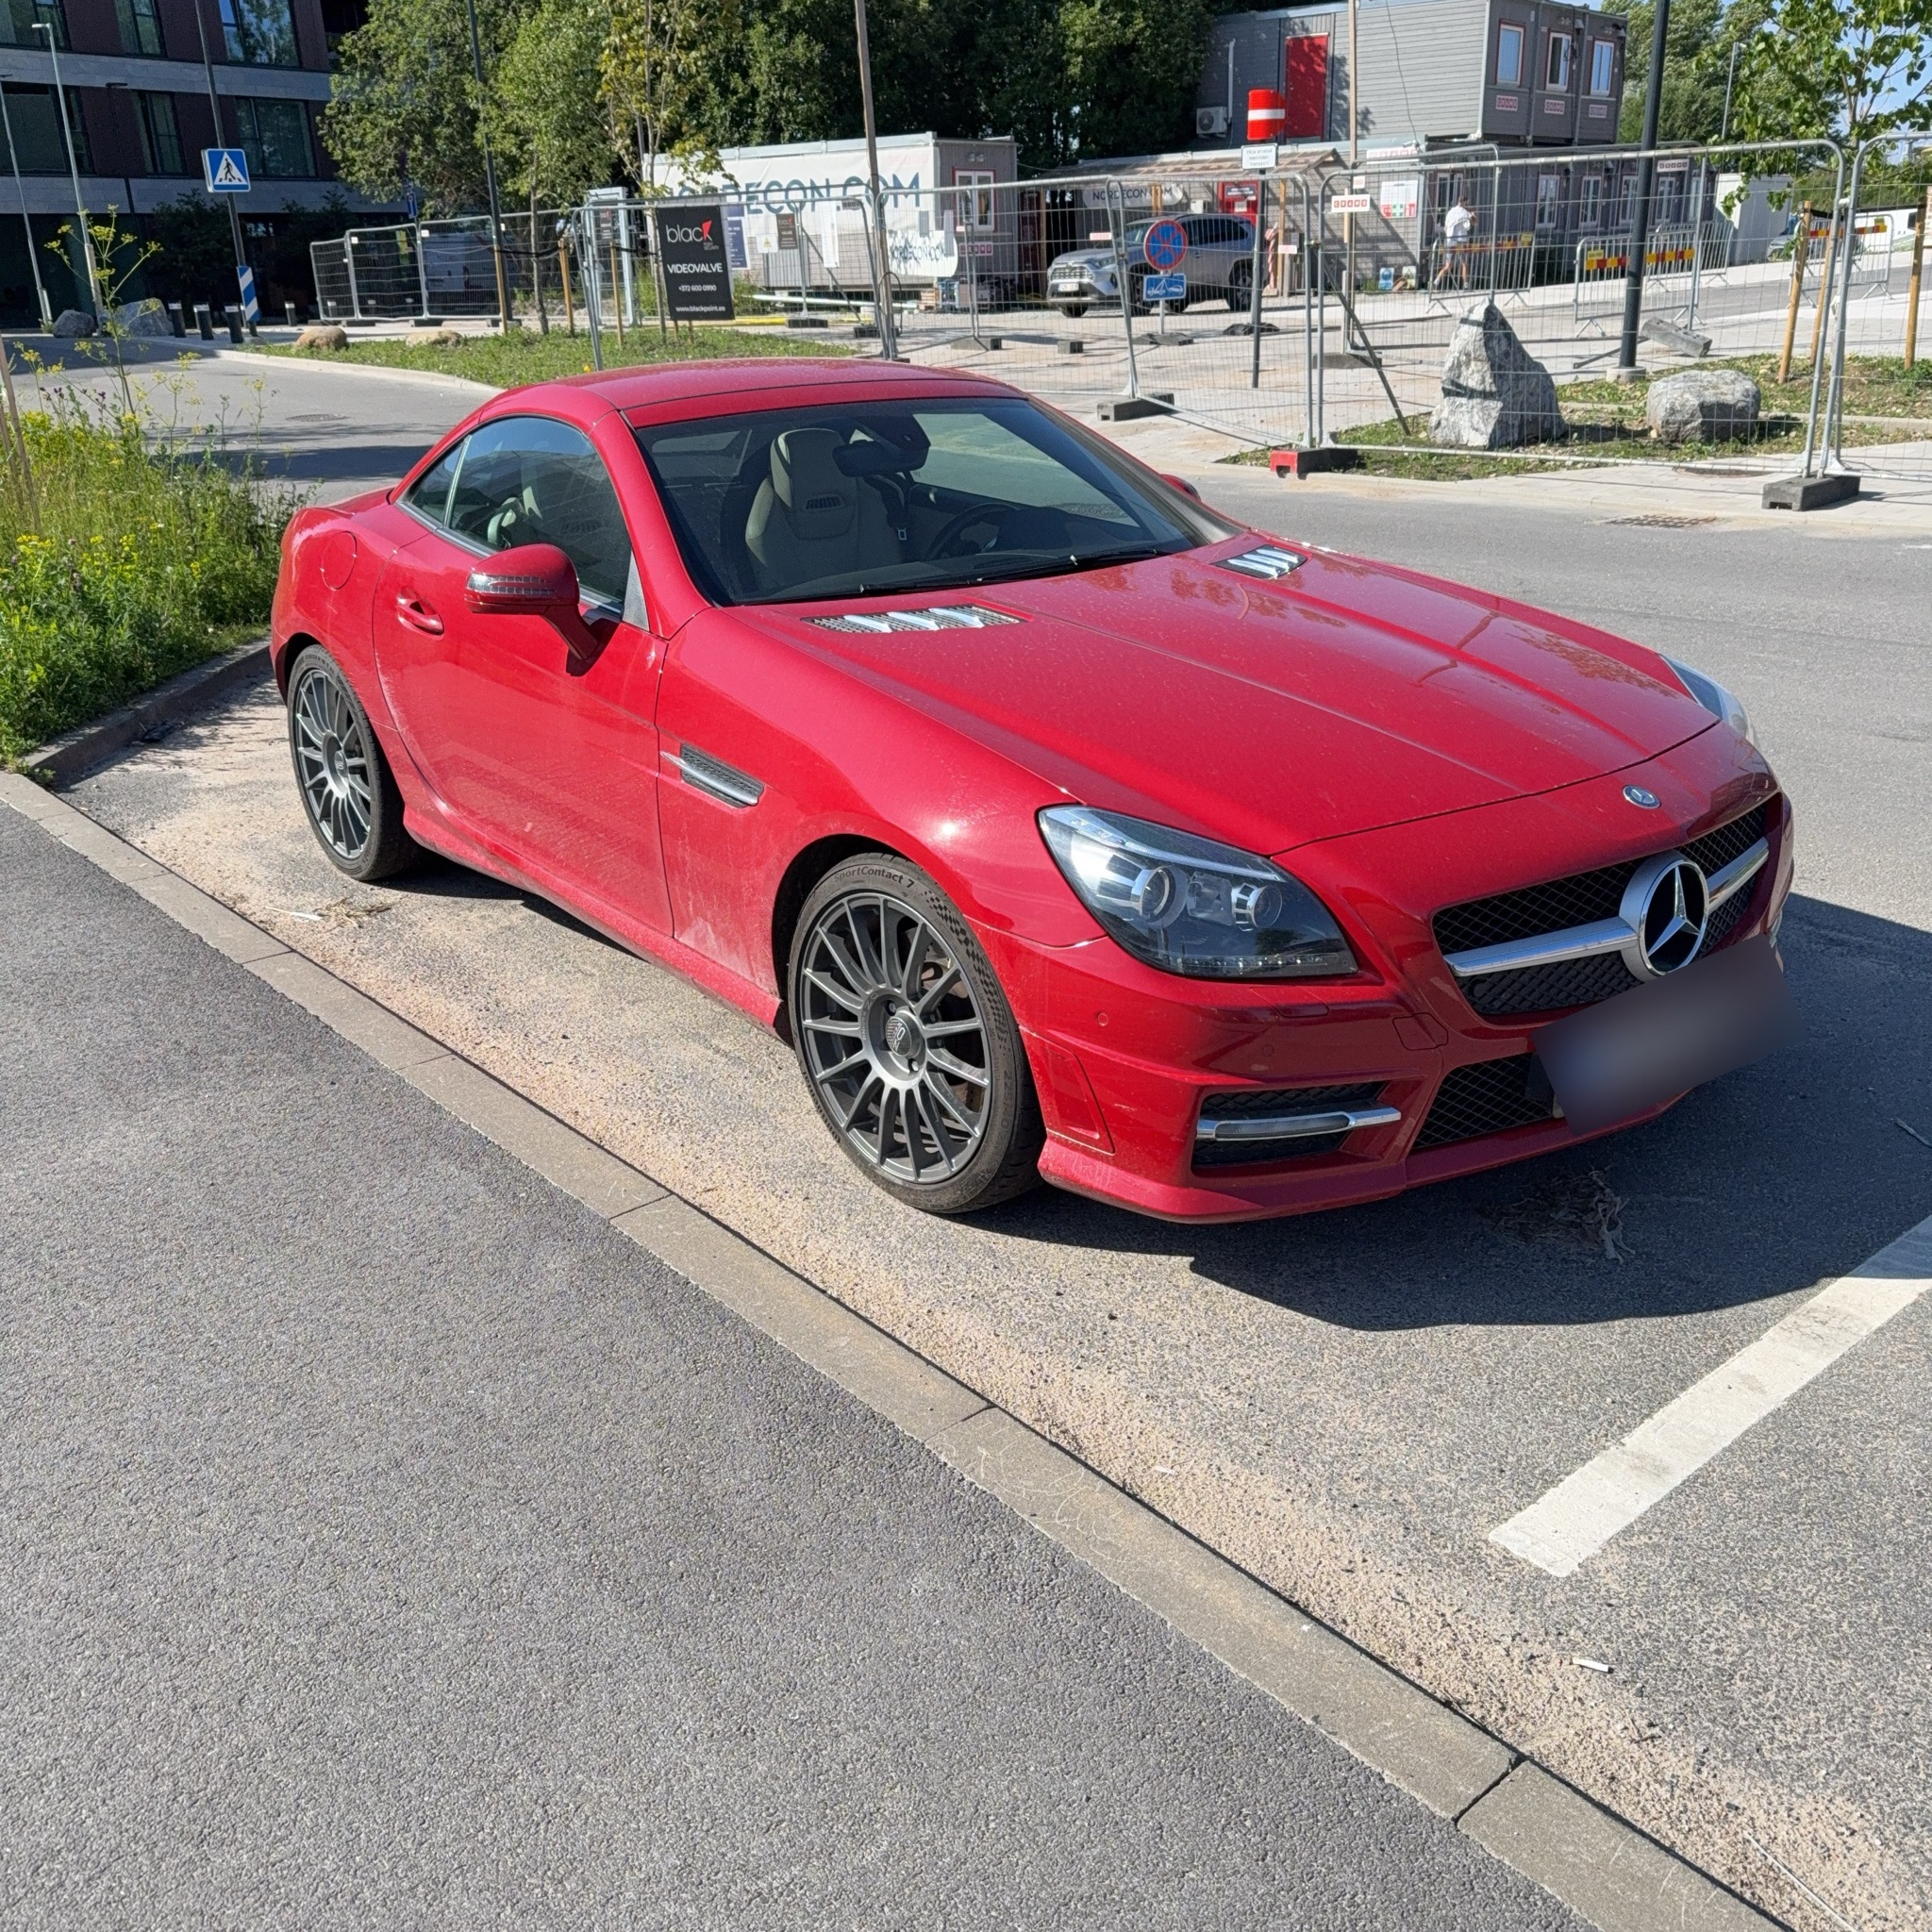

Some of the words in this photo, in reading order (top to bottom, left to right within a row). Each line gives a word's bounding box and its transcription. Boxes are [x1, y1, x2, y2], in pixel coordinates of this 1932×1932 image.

[664, 172, 920, 215] DECON.COM
[1092, 186, 1173, 200] NORDECON.M
[667, 263, 723, 274] VIDEOVALVE
[833, 866, 904, 885] SportContact
[906, 878, 915, 889] 7
